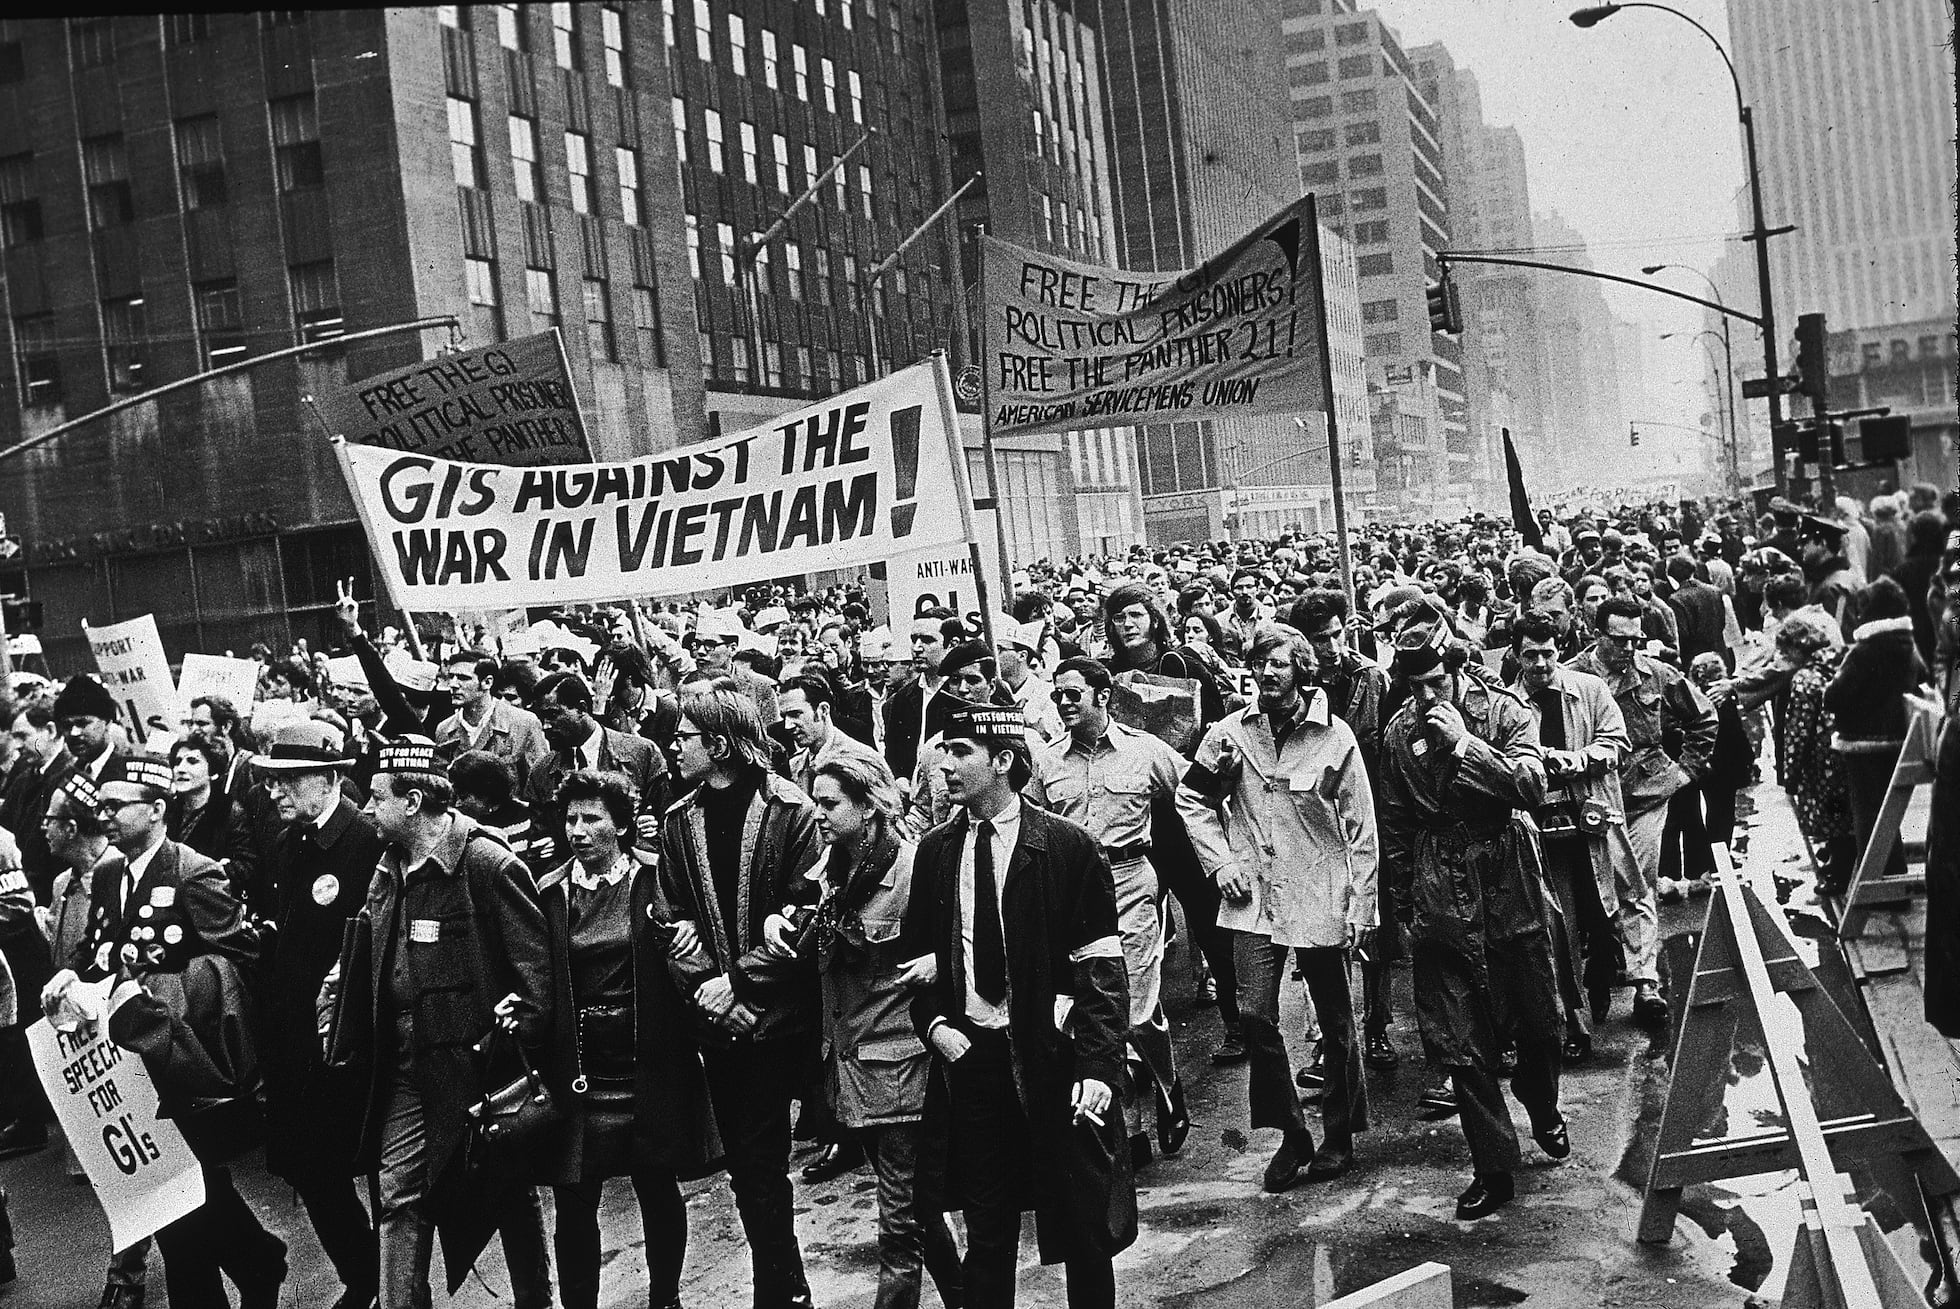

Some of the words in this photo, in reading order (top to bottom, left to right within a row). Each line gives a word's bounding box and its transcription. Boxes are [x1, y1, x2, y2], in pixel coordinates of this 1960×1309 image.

[1022, 263, 1098, 312] FREE
[1000, 352, 1055, 393] FREE
[1063, 354, 1114, 391] THE
[1124, 327, 1232, 383] PANTHER
[1239, 309, 1297, 361] 21!
[1005, 306, 1149, 350] POLITICAL
[359, 374, 425, 421] FREE
[418, 357, 489, 394] THE
[483, 350, 518, 376] GI
[994, 402, 1076, 425] AMERICAN
[1202, 377, 1261, 407] UNION
[484, 414, 575, 457] PANTHER
[512, 436, 758, 514] AGAINST
[773, 401, 871, 476] THE
[392, 527, 512, 587] WAR
[528, 516, 597, 581] IN
[616, 471, 878, 573] VIETNAM
[975, 724, 988, 734] IN
[62, 1039, 122, 1095] SPEECH
[87, 1078, 123, 1119] FOR
